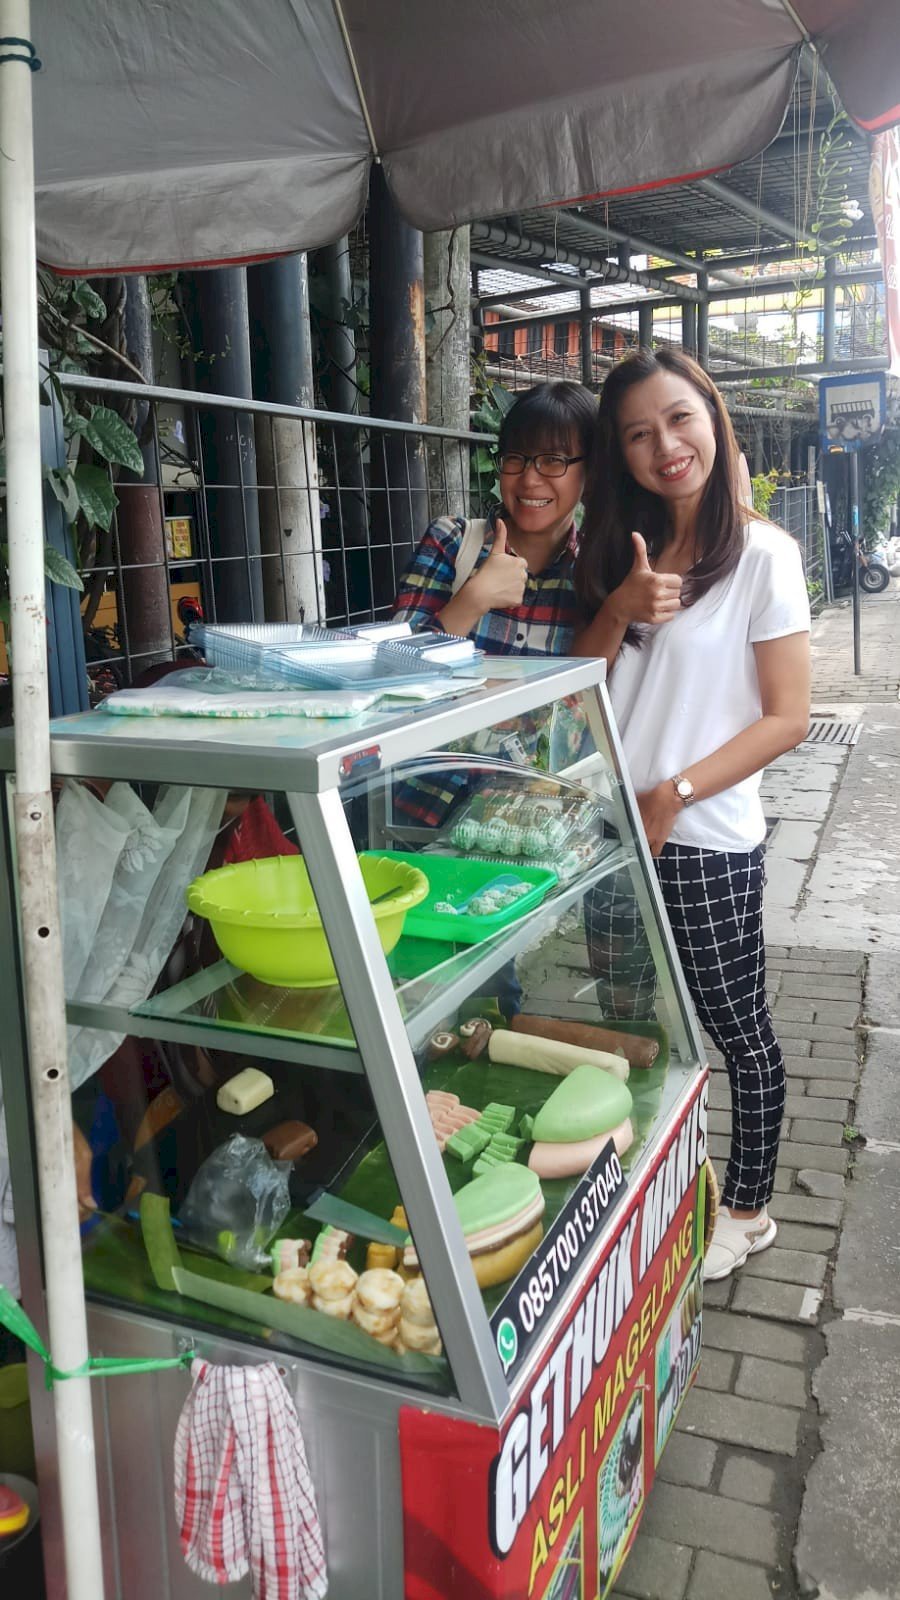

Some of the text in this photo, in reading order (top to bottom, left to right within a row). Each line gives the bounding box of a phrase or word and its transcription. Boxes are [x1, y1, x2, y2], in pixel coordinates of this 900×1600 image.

[493, 1207, 640, 1555] GETHUK
[518, 1151, 623, 1333] 085700137040
[527, 1210, 694, 1598] ASLI MAGELANG
